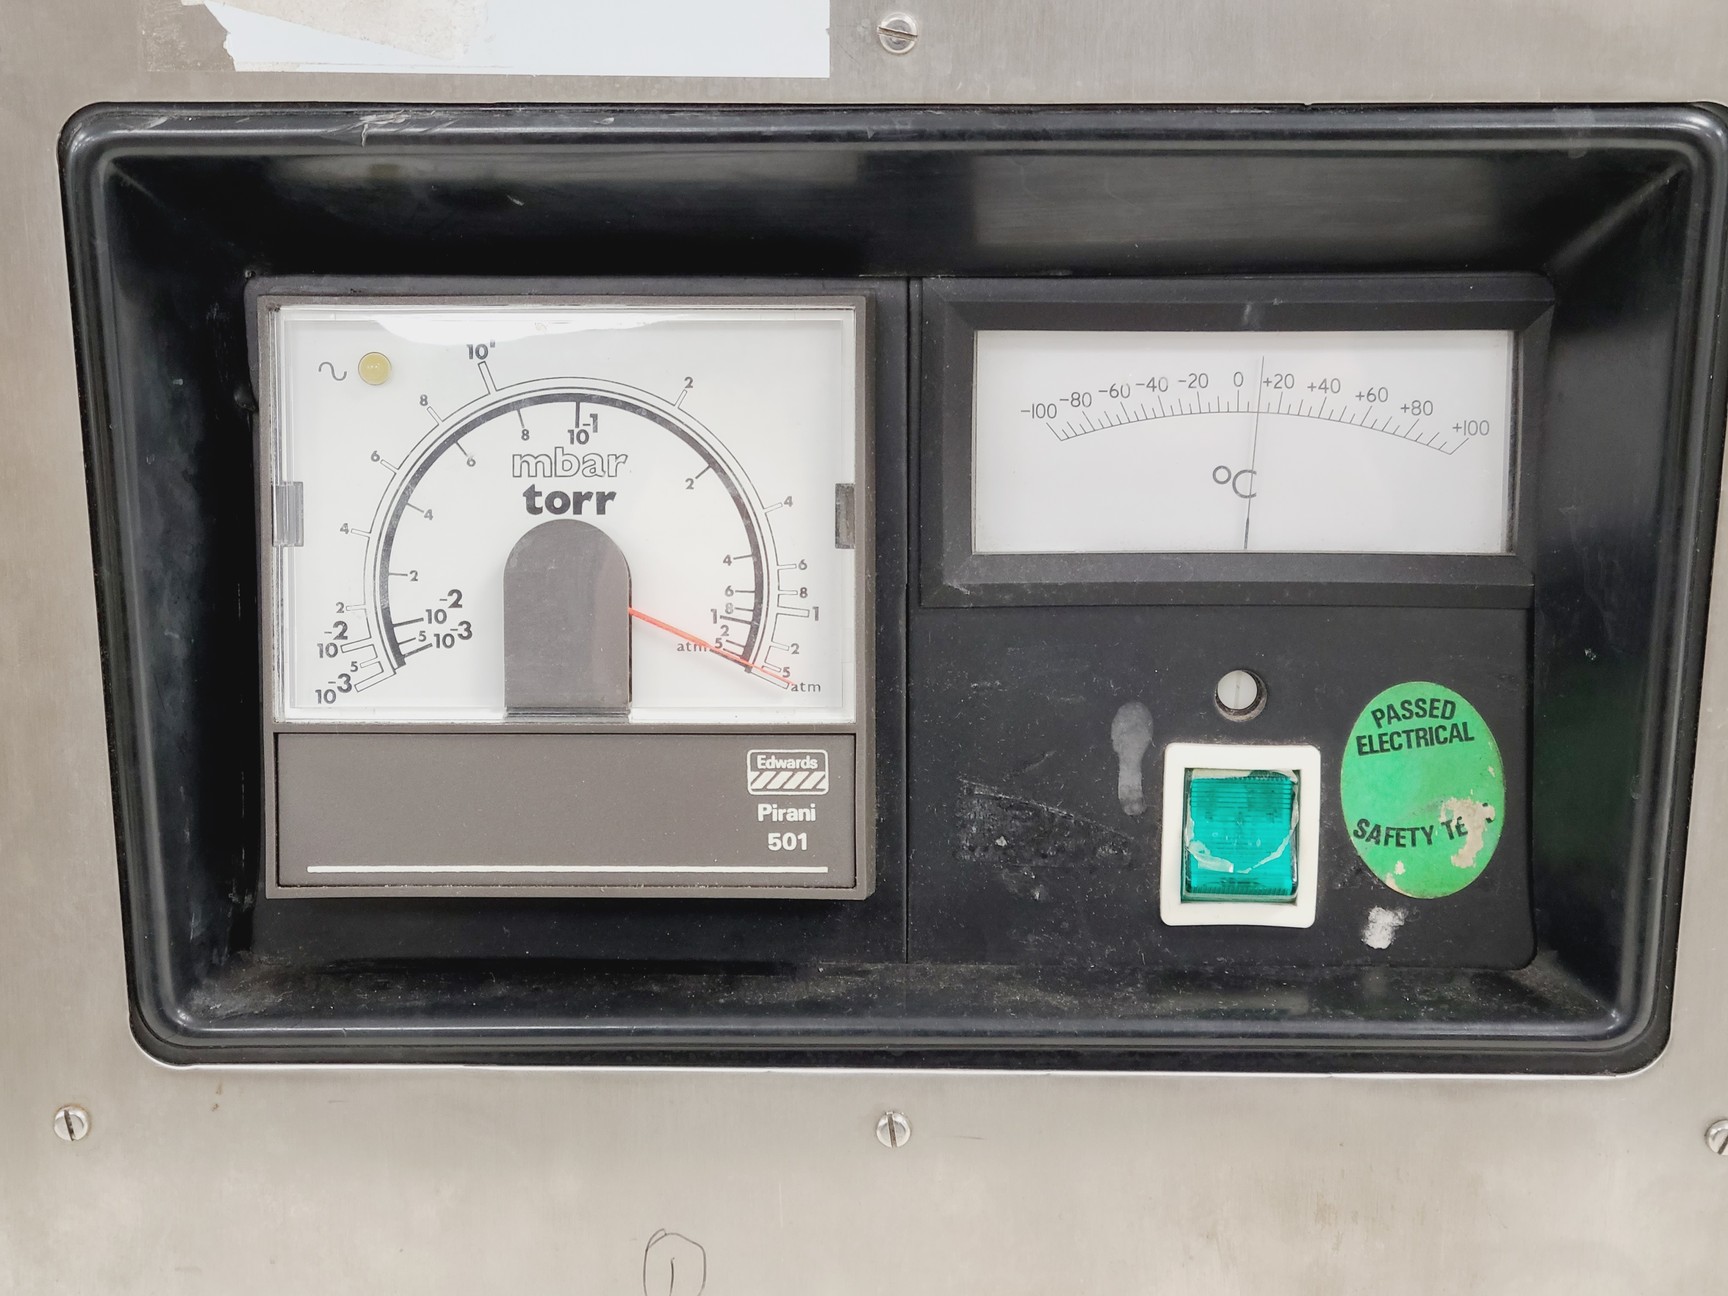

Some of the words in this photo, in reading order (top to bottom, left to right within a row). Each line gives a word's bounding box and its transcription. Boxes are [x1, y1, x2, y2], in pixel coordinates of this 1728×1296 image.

[684, 376, 694, 389] 2
[1135, 376, 1169, 393] -40
[1177, 373, 1209, 389] -20
[1233, 371, 1244, 387] 0
[1262, 373, 1295, 389] +20
[1098, 382, 1131, 399] -60
[1307, 378, 1341, 394] +40
[419, 394, 428, 407] 8
[1059, 391, 1093, 408] -80
[1355, 386, 1389, 403] +60
[1020, 403, 1058, 419] -100
[1400, 400, 1434, 417] +80
[1452, 419, 1490, 436] +100
[520, 429, 530, 441] 8
[370, 450, 381, 462] 6
[466, 456, 477, 468] 6
[512, 446, 628, 478] mbar
[684, 478, 695, 490] 2
[522, 483, 617, 515] torr
[783, 496, 793, 508] 4
[423, 509, 434, 521] 4
[339, 523, 350, 535] 4
[722, 554, 732, 567] 4
[798, 559, 808, 571] 6
[409, 570, 419, 582] 2
[724, 585, 734, 598] 6
[799, 586, 808, 599] 8
[335, 602, 345, 614] 2
[724, 602, 734, 615] 8
[812, 606, 820, 622] 1
[710, 608, 718, 625] 1
[418, 631, 427, 642] 5
[720, 624, 730, 637] 2
[714, 637, 723, 650] 5
[790, 643, 800, 655] 2
[350, 661, 359, 673] 5
[782, 667, 791, 678] 5
[790, 680, 822, 693] atm
[1371, 698, 1456, 729] PASSED
[1356, 721, 1475, 756] ELECTRICAL
[756, 754, 819, 770] Edwards
[757, 803, 816, 822] Pirani
[1353, 818, 1434, 848] SAFETY
[767, 832, 807, 851] 501
